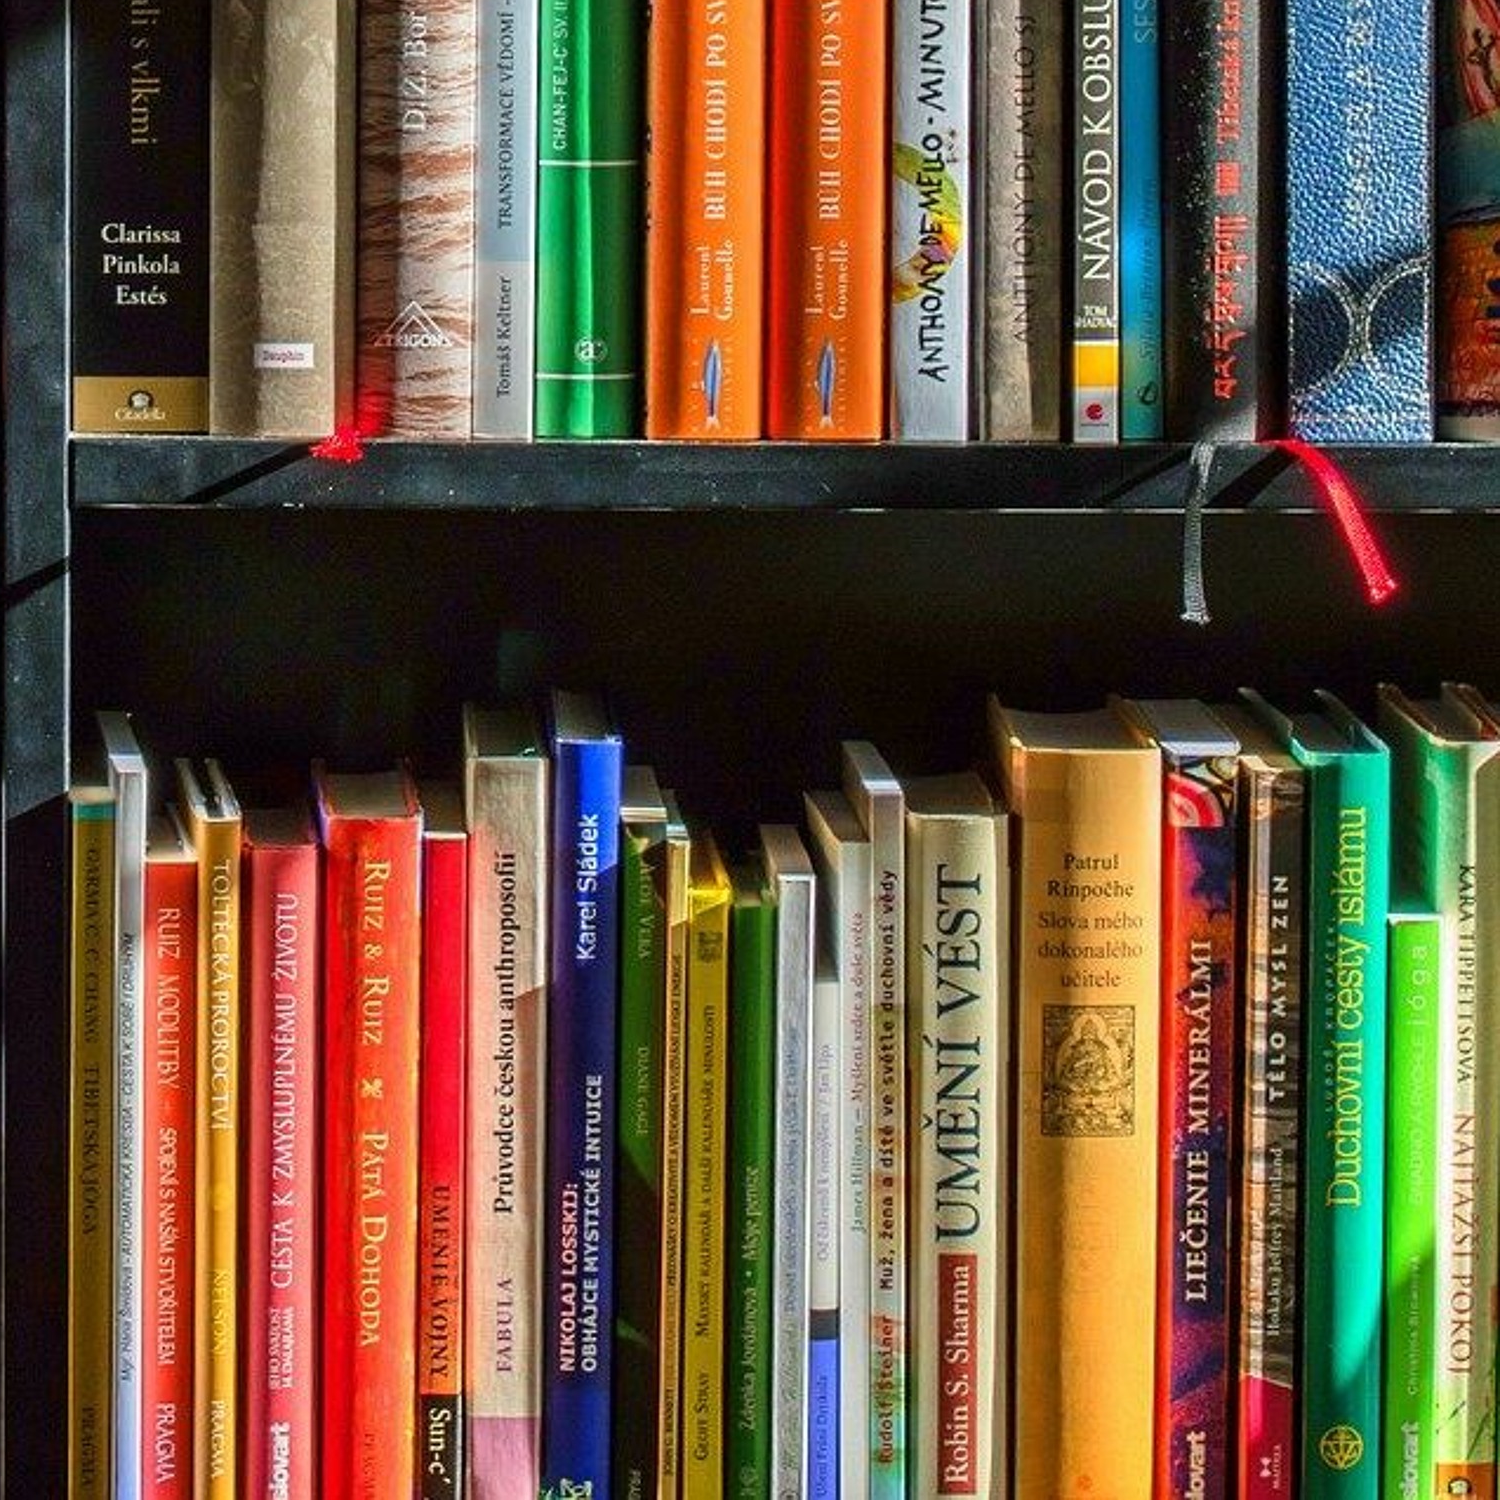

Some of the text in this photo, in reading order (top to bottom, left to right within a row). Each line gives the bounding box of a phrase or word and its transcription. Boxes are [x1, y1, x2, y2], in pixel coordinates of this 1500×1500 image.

[131, 61, 161, 145] vlkmi
[1083, 113, 1111, 137] K
[496, 85, 515, 229] TRANSFORMACE
[100, 222, 181, 244] Clarissa
[1077, 148, 1111, 281] NÁVOD
[102, 254, 181, 275] Pinkola
[116, 285, 167, 306] Estés
[496, 274, 513, 335] Keltner
[917, 257, 949, 382] ANTHONY
[495, 340, 512, 399] Tomáš
[361, 860, 392, 931] RUIZ
[575, 813, 599, 961] Karel Sládek
[1062, 853, 1120, 871] Patrul
[1272, 875, 1290, 929] ZEN
[363, 942, 382, 960] &
[1037, 911, 1144, 930] Slova mého
[1037, 940, 1145, 960] dokonalého
[361, 973, 391, 1046] RUIZ
[1060, 969, 1122, 989] učitele
[1270, 943, 1288, 1019] MYSL
[1326, 805, 1372, 1207] Duchovní cesty islámu
[211, 987, 233, 1131] PROROCTVÍ
[269, 893, 298, 1290] CESTA K ZMYSLUPLNÉMU ŽIVOTU
[493, 1016, 516, 1098] českou
[493, 1102, 516, 1215] Průvodce
[1179, 940, 1212, 1303] LIEČENIE MINERÁLMI
[154, 908, 182, 1483] RUIZ MODLITBY PRAGMA
[877, 923, 896, 1467] Rudolf Steiner žena duchovní
[922, 863, 982, 1485] Robin S. Sharma UMĚNÍ VÉST
[580, 1073, 603, 1373] OBHÁJCE MYSTICKÉ INTUICE
[359, 1214, 389, 1347] DOHODA
[429, 1184, 450, 1377] UMENIE VOJNY
[495, 1277, 514, 1373] FABULA
[559, 1183, 579, 1373] NIKOLAJ LOSSKIJ:
[1447, 1272, 1476, 1376] POKOJ
